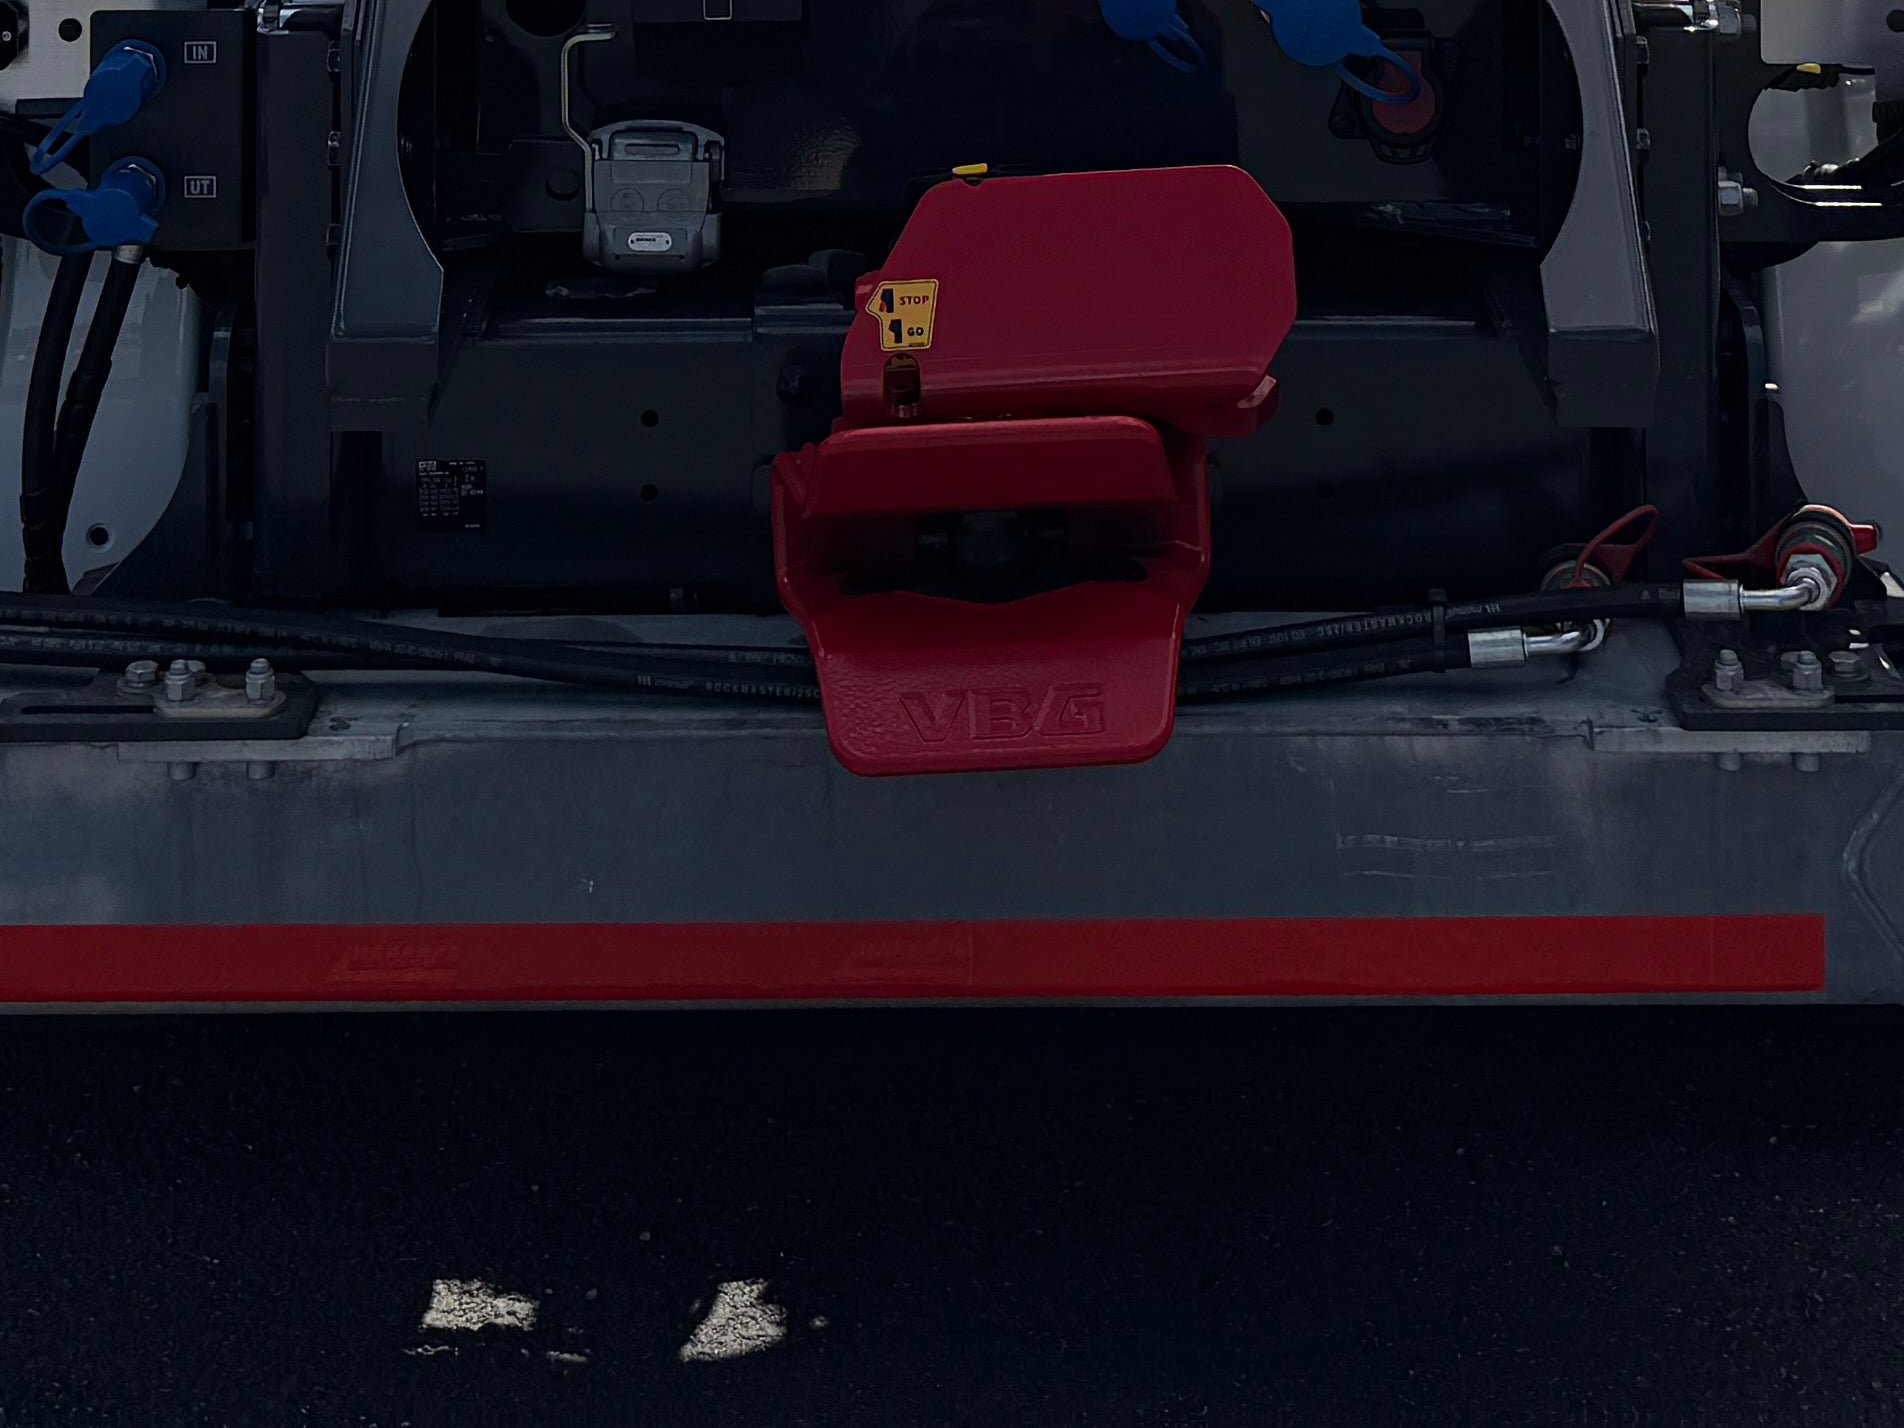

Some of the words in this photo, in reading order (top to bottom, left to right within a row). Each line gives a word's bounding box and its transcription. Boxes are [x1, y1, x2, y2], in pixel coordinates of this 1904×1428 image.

[192, 45, 208, 60] IN
[190, 179, 211, 195] UT
[899, 295, 930, 306] STOP
[907, 327, 924, 337] GO
[898, 684, 1104, 742] VBG
